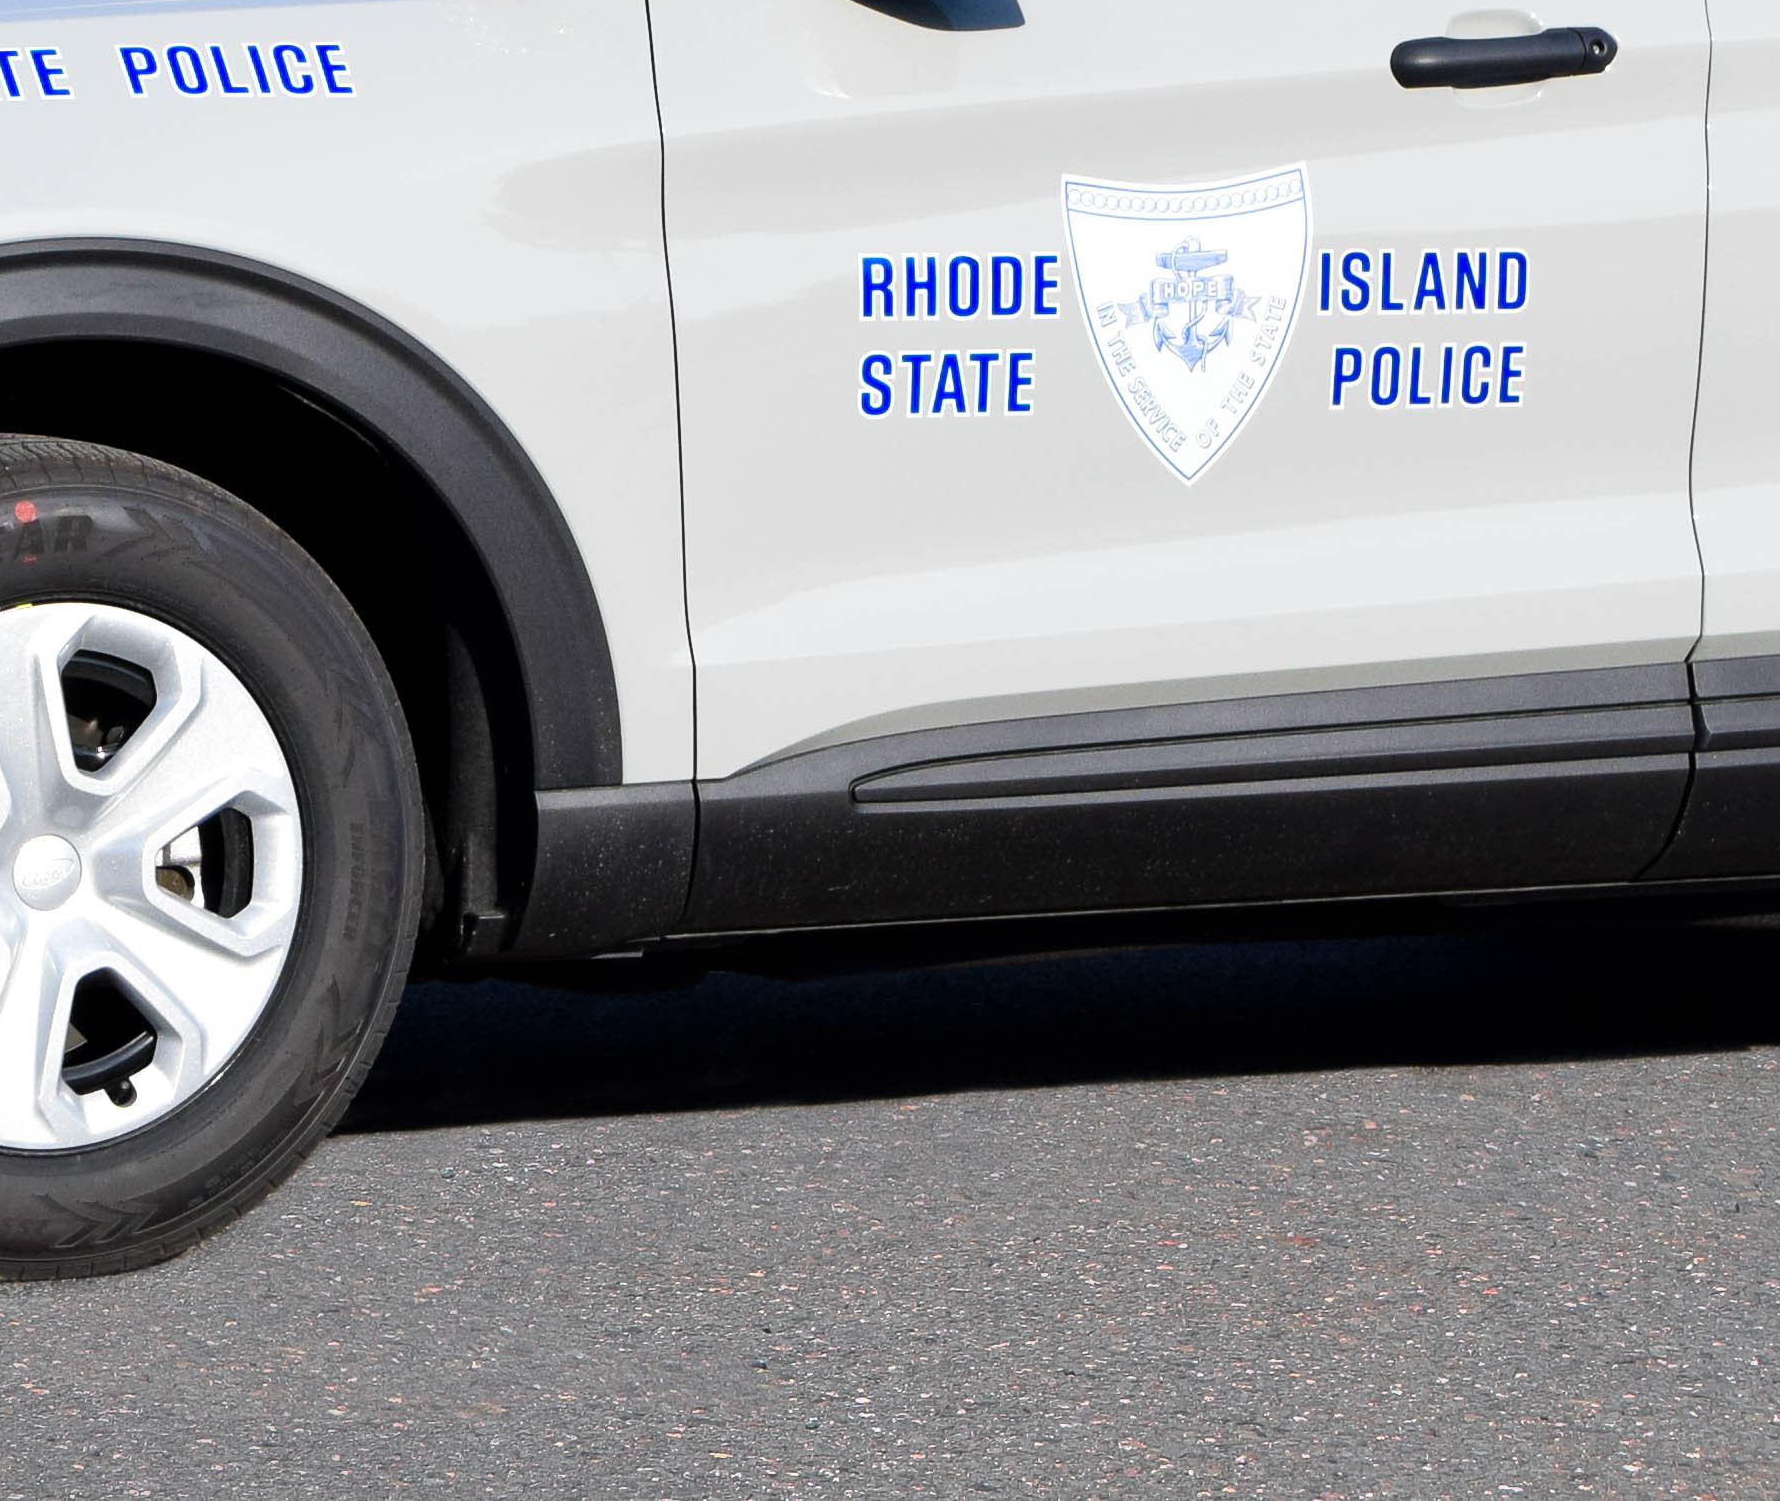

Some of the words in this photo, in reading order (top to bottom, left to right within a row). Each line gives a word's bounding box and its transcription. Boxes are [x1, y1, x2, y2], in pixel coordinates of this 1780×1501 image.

[119, 44, 353, 95] POLICE
[861, 254, 1058, 317] RHODE
[1163, 281, 1219, 297] HOPE
[1320, 251, 1528, 311] ISLAND
[860, 351, 1033, 415] STATE
[1097, 301, 1117, 327] IN
[1108, 331, 1136, 377] THE
[1128, 376, 1186, 452] SERVICE
[1196, 418, 1220, 449] OF
[1222, 371, 1255, 414] THE
[1249, 296, 1287, 367] STATE
[1332, 345, 1523, 405] POLICE
